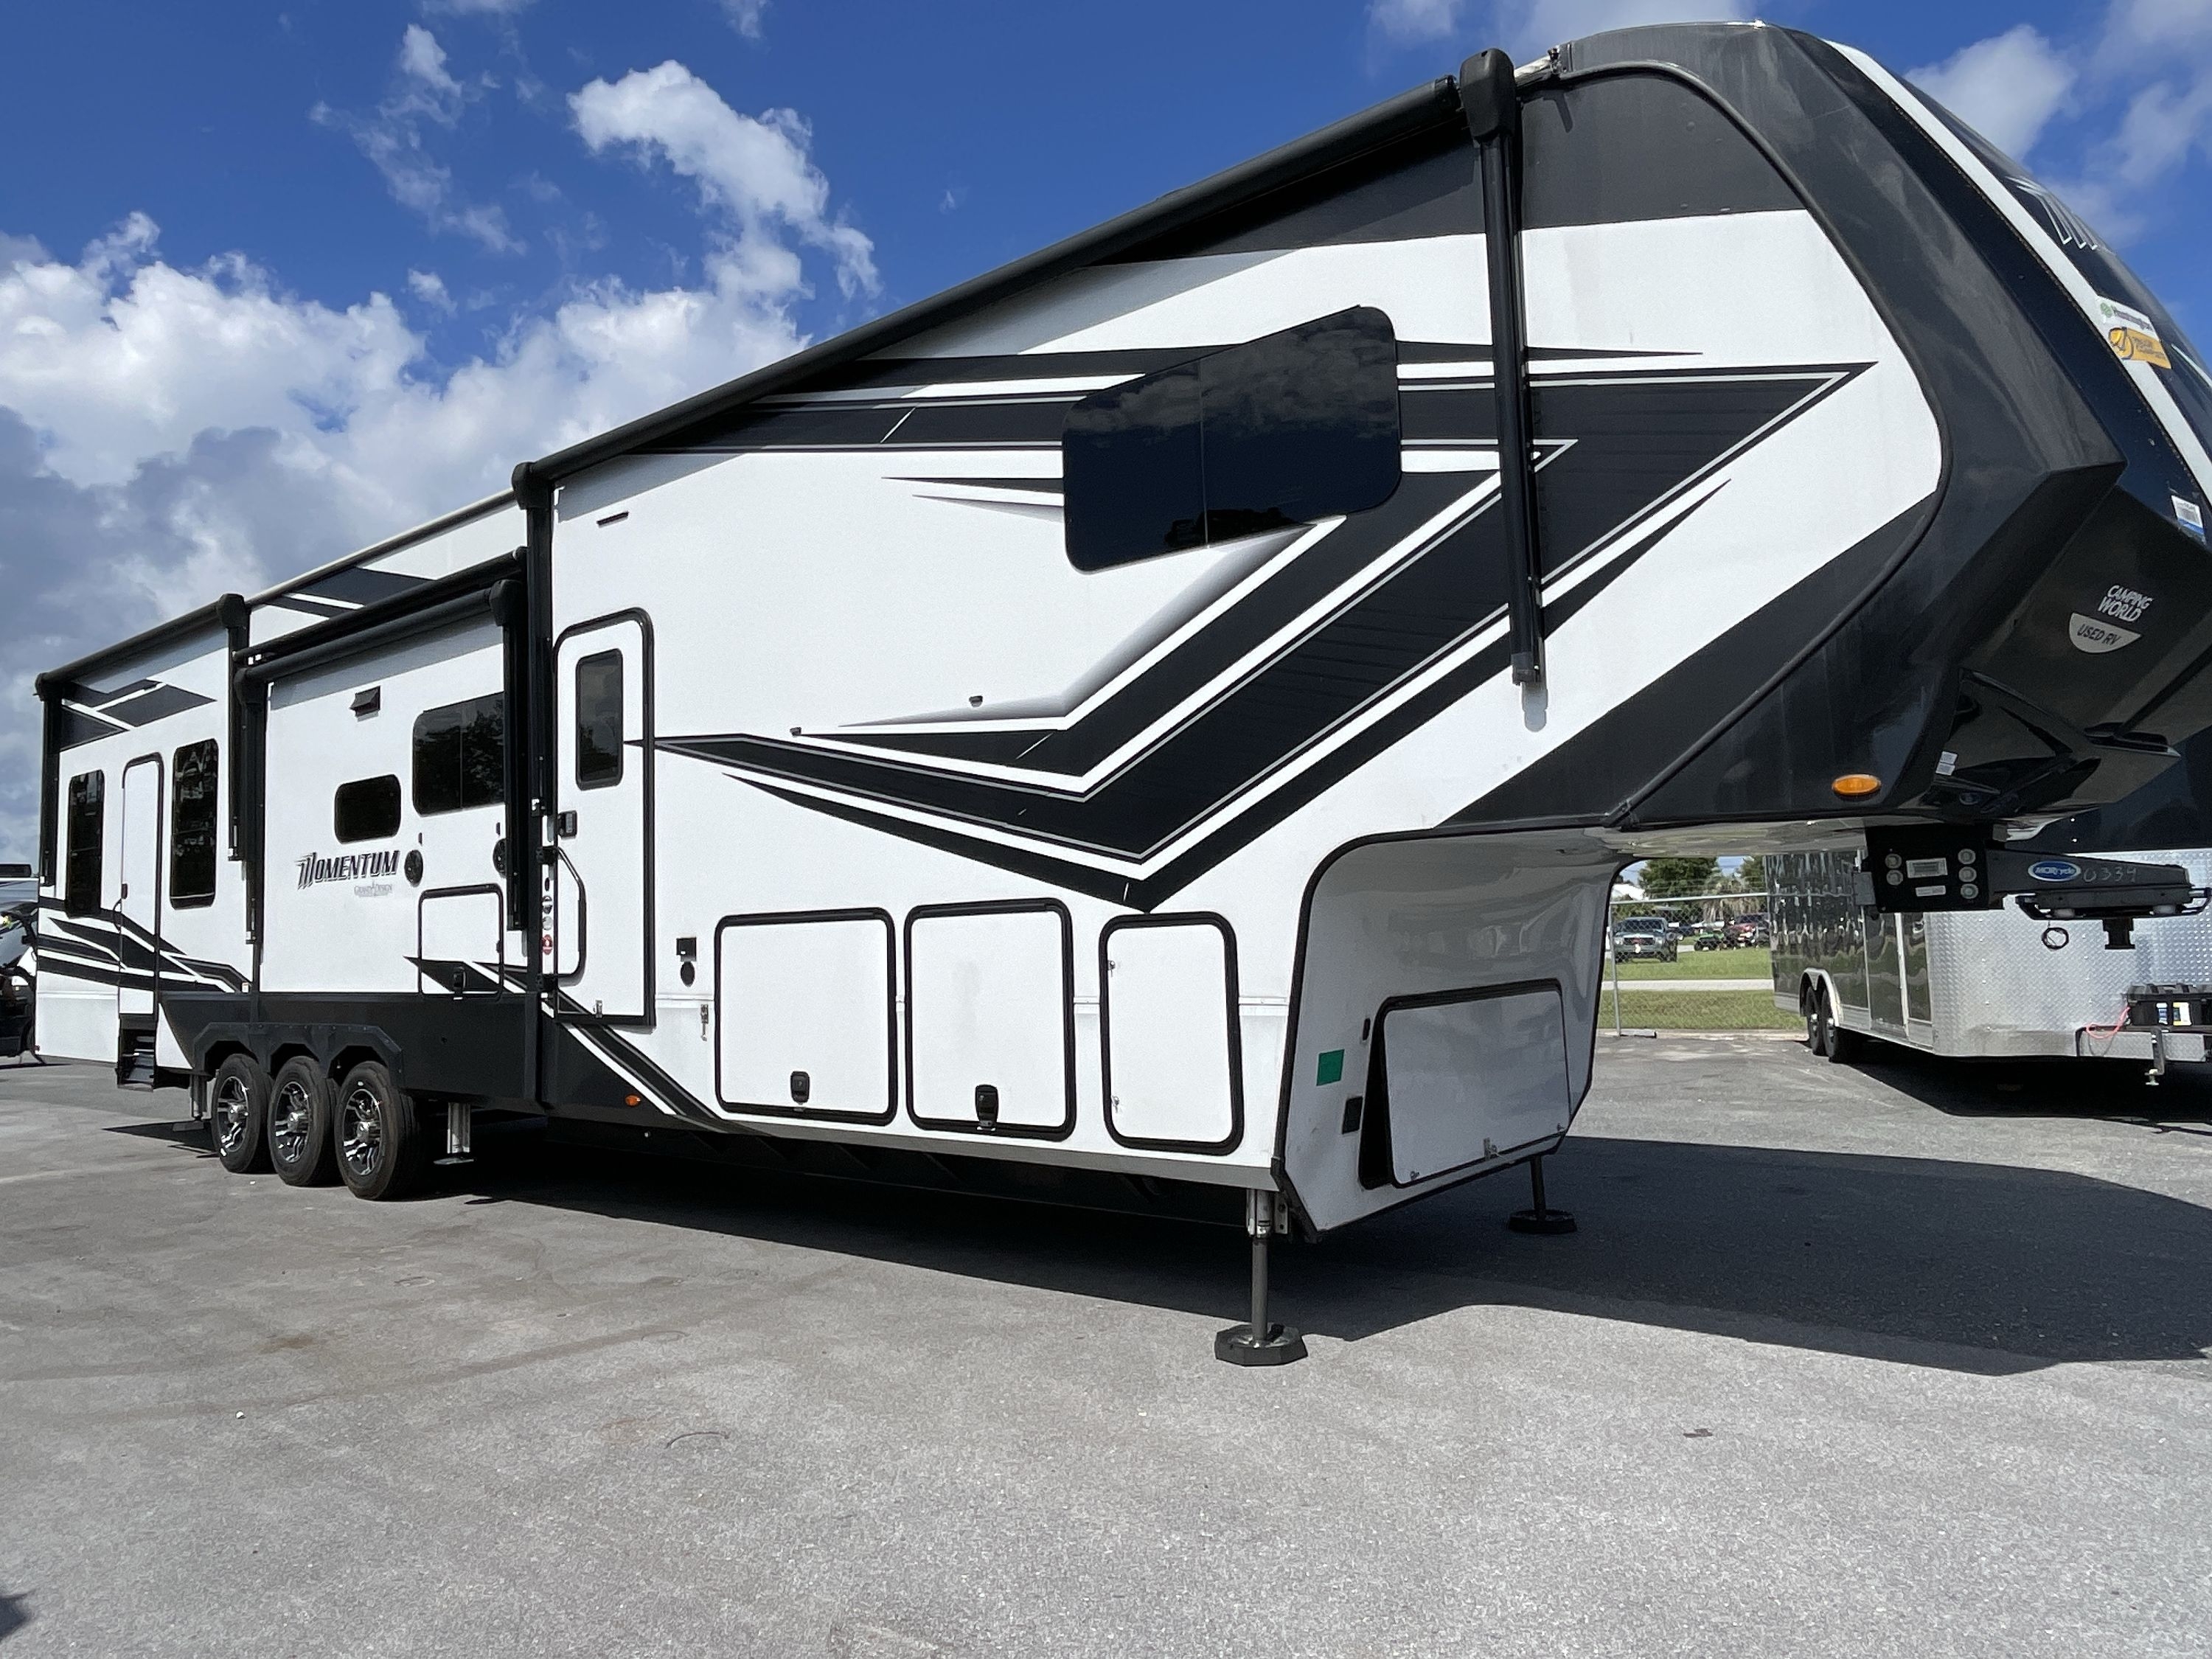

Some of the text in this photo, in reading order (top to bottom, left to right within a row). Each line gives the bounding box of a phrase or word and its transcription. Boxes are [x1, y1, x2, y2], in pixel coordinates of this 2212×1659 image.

[2107, 585, 2153, 609] CAMPING
[2098, 597, 2142, 622] WORLD
[2077, 624, 2121, 645] USED RV
[296, 850, 400, 890] MOMENTUM
